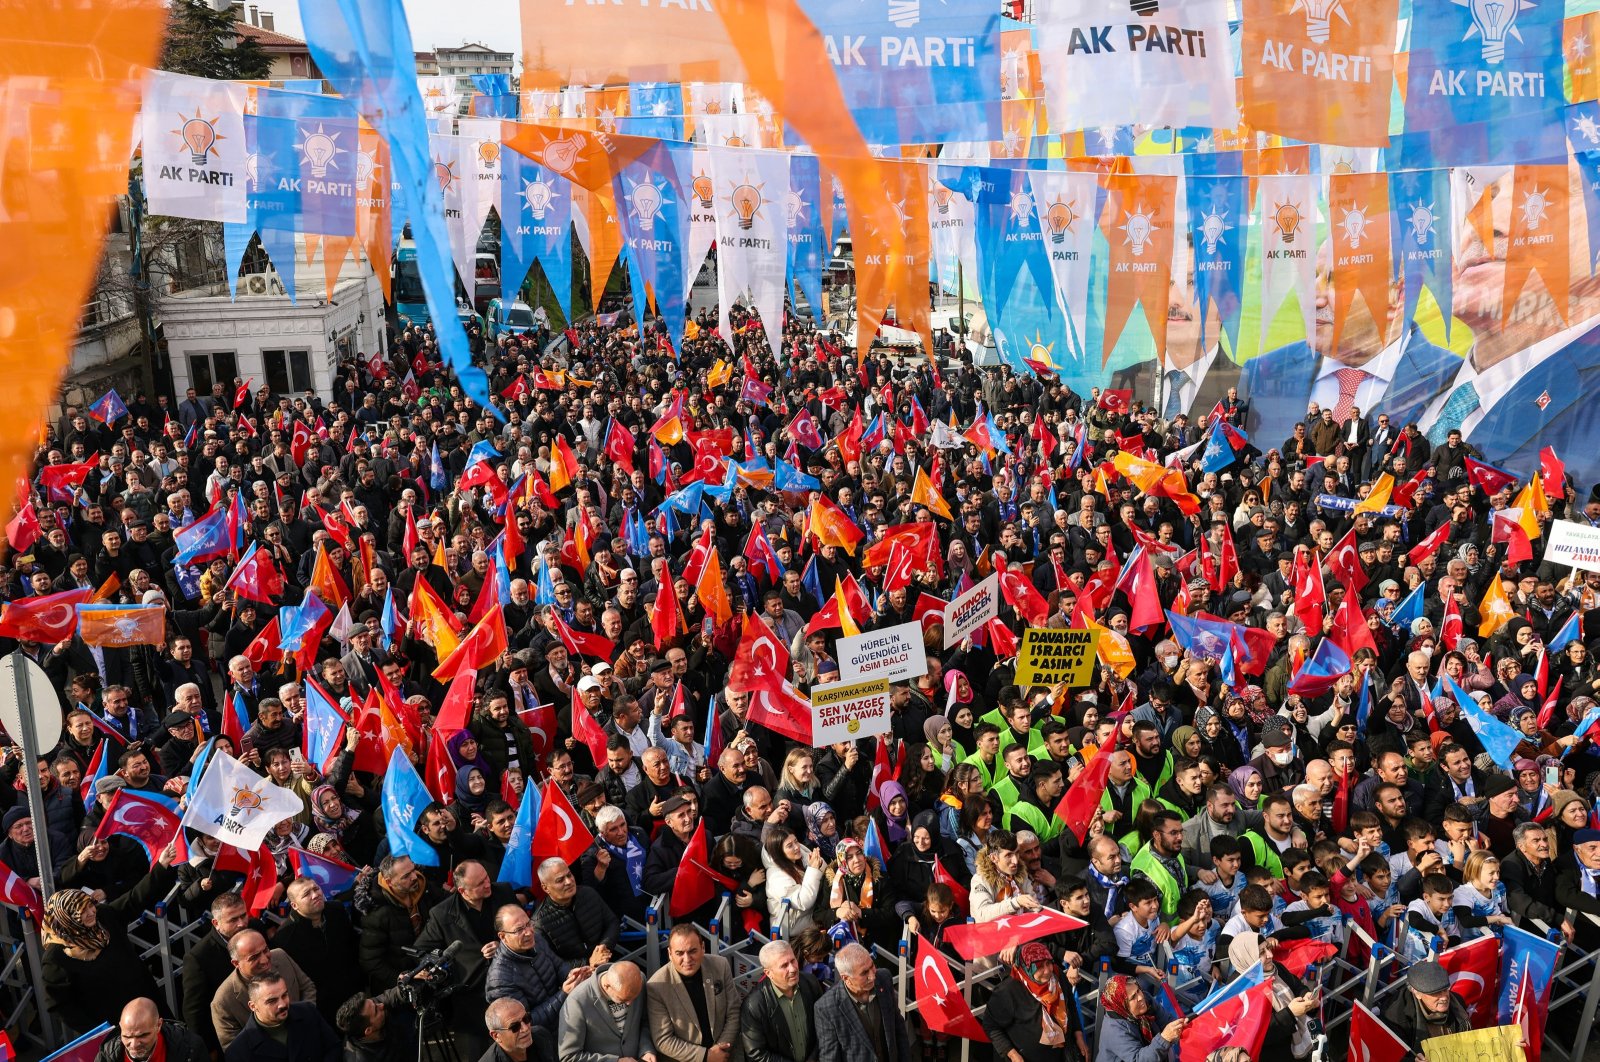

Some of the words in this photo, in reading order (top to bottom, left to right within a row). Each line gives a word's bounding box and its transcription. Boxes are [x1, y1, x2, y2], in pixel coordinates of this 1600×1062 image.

[1067, 25, 1117, 56] AK
[824, 35, 867, 66] AK
[1262, 39, 1294, 72] AK
[1429, 69, 1466, 96] AK
[160, 165, 182, 181] AK
[278, 177, 301, 192] AK
[516, 226, 530, 235] AK
[721, 236, 735, 247] AK
[1514, 238, 1525, 246] AK
[865, 255, 881, 264] AK
[1267, 250, 1280, 259] AK
[1338, 256, 1349, 266] AK
[1115, 263, 1129, 272] AK
[952, 586, 988, 622] ALTINOK
[956, 593, 992, 627] GELECEK
[1029, 632, 1091, 643] DAVASINA
[902, 642, 912, 651] EL
[1030, 645, 1086, 656] ISRARCI
[860, 661, 881, 673] ASIM
[883, 653, 909, 667] BALCI
[1039, 658, 1073, 670] ASIM
[1032, 673, 1075, 684] BALCI
[817, 683, 885, 702] KARŞIYAKA-KAYAŞ
[819, 706, 840, 718] SEN
[843, 697, 885, 713] VAZGEÇ
[822, 714, 851, 727] ARTIK
[854, 708, 884, 720] YAVAŞ
[1510, 958, 1518, 979] AK
